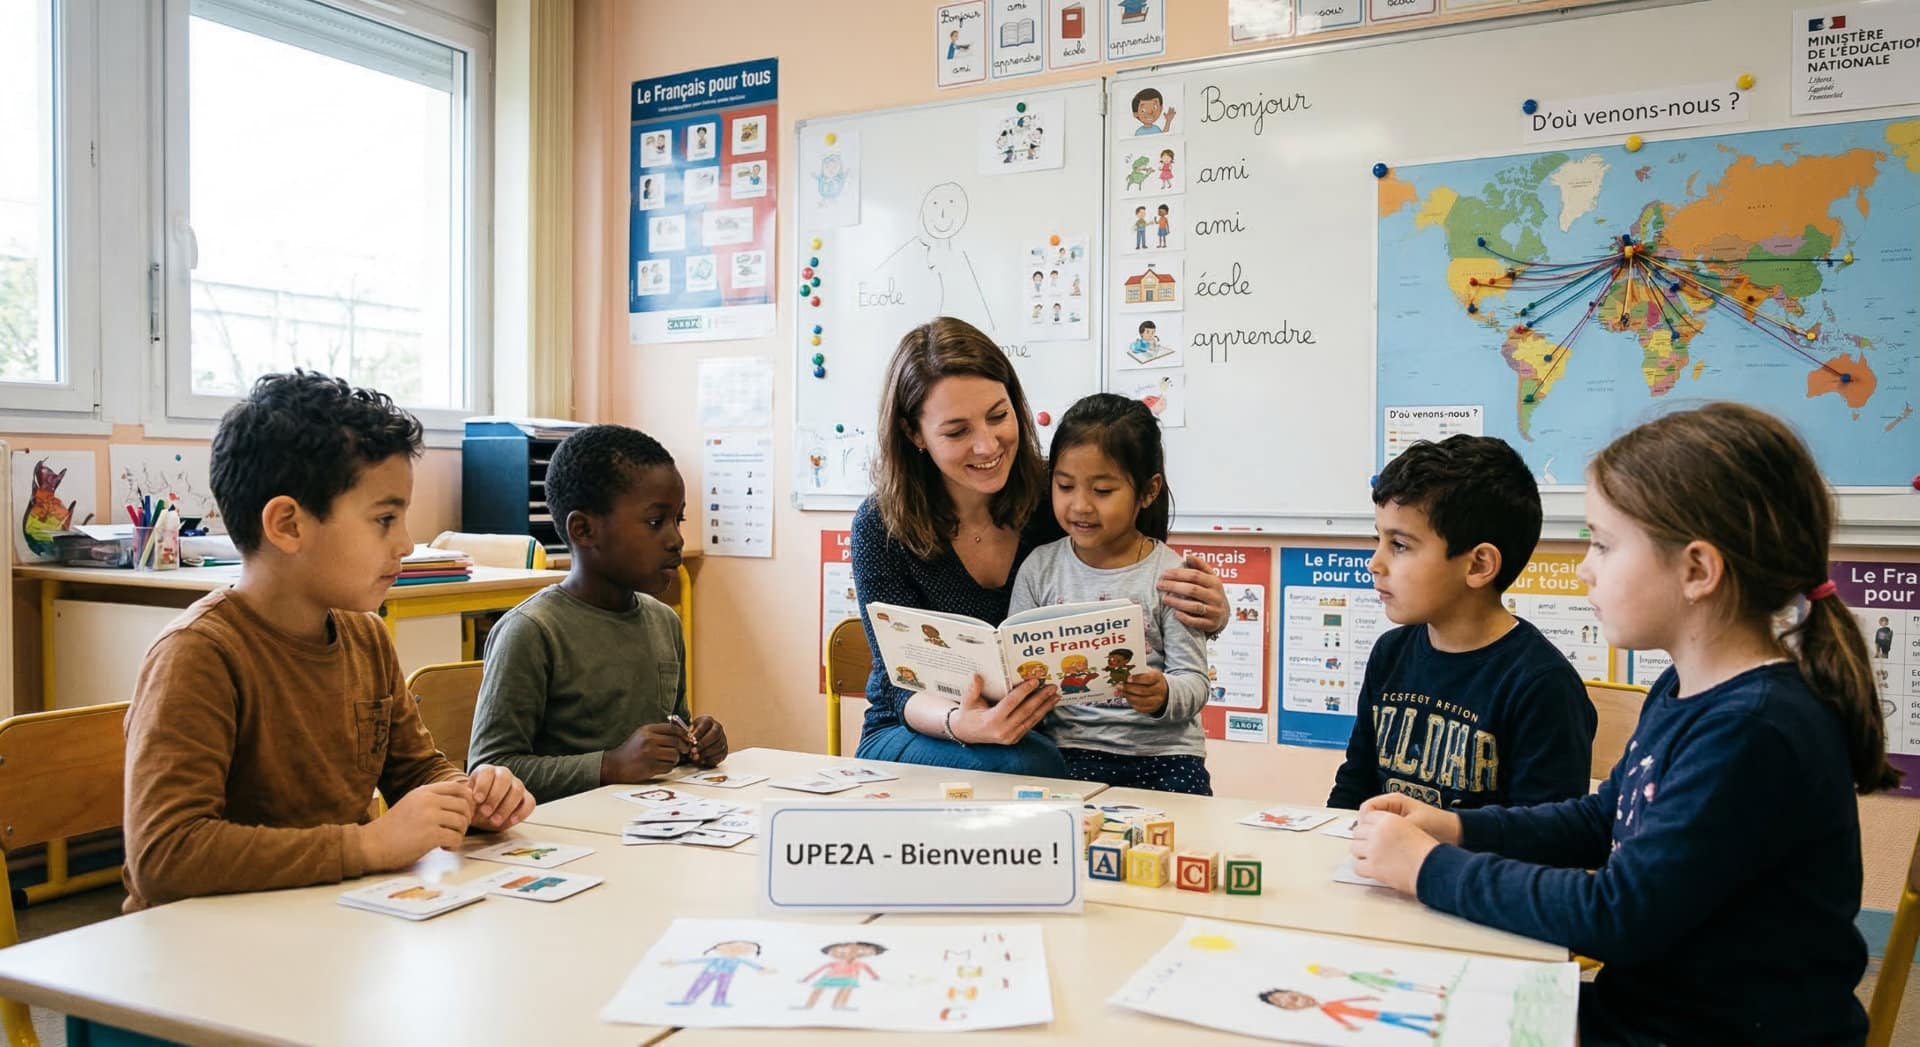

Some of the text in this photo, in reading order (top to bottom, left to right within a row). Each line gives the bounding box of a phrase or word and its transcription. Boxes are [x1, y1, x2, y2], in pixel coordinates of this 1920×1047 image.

[940, 10, 981, 28] Bonjour
[1110, 32, 1162, 55] apprendre
[1808, 29, 1884, 47] MINISTÈRE
[1063, 41, 1086, 57] école
[1808, 49, 1825, 60] DE
[952, 64, 971, 73] ami
[993, 53, 1042, 73] apprendre
[1808, 54, 1890, 72] NATIONALE
[637, 88, 651, 105] Le
[654, 77, 706, 103] Français
[708, 75, 739, 97] pour
[741, 69, 771, 88] tous
[1201, 85, 1312, 136] Bonjour
[1532, 92, 1740, 132] D'où venons-nous ?
[1196, 157, 1250, 184] ami
[1195, 211, 1246, 236] ami
[1194, 262, 1253, 297] école
[1192, 319, 1317, 364] apprendre
[1390, 410, 1410, 419] D'où
[1473, 409, 1479, 417] ?
[1305, 553, 1323, 567] Le
[1527, 559, 1577, 577] ançai
[1312, 570, 1375, 585] pour to
[1516, 575, 1580, 590] ur tous
[1851, 567, 1918, 585] Le Fra
[1864, 589, 1915, 605] pour
[1012, 617, 1131, 645] Mon Imagier
[1022, 633, 1126, 657] de Français
[785, 843, 874, 865] UPE2A
[901, 842, 1042, 865] Bienvenue
[1052, 842, 1059, 865] !
[1094, 852, 1115, 875] A
[1183, 864, 1203, 884] C
[1234, 867, 1255, 888] D
